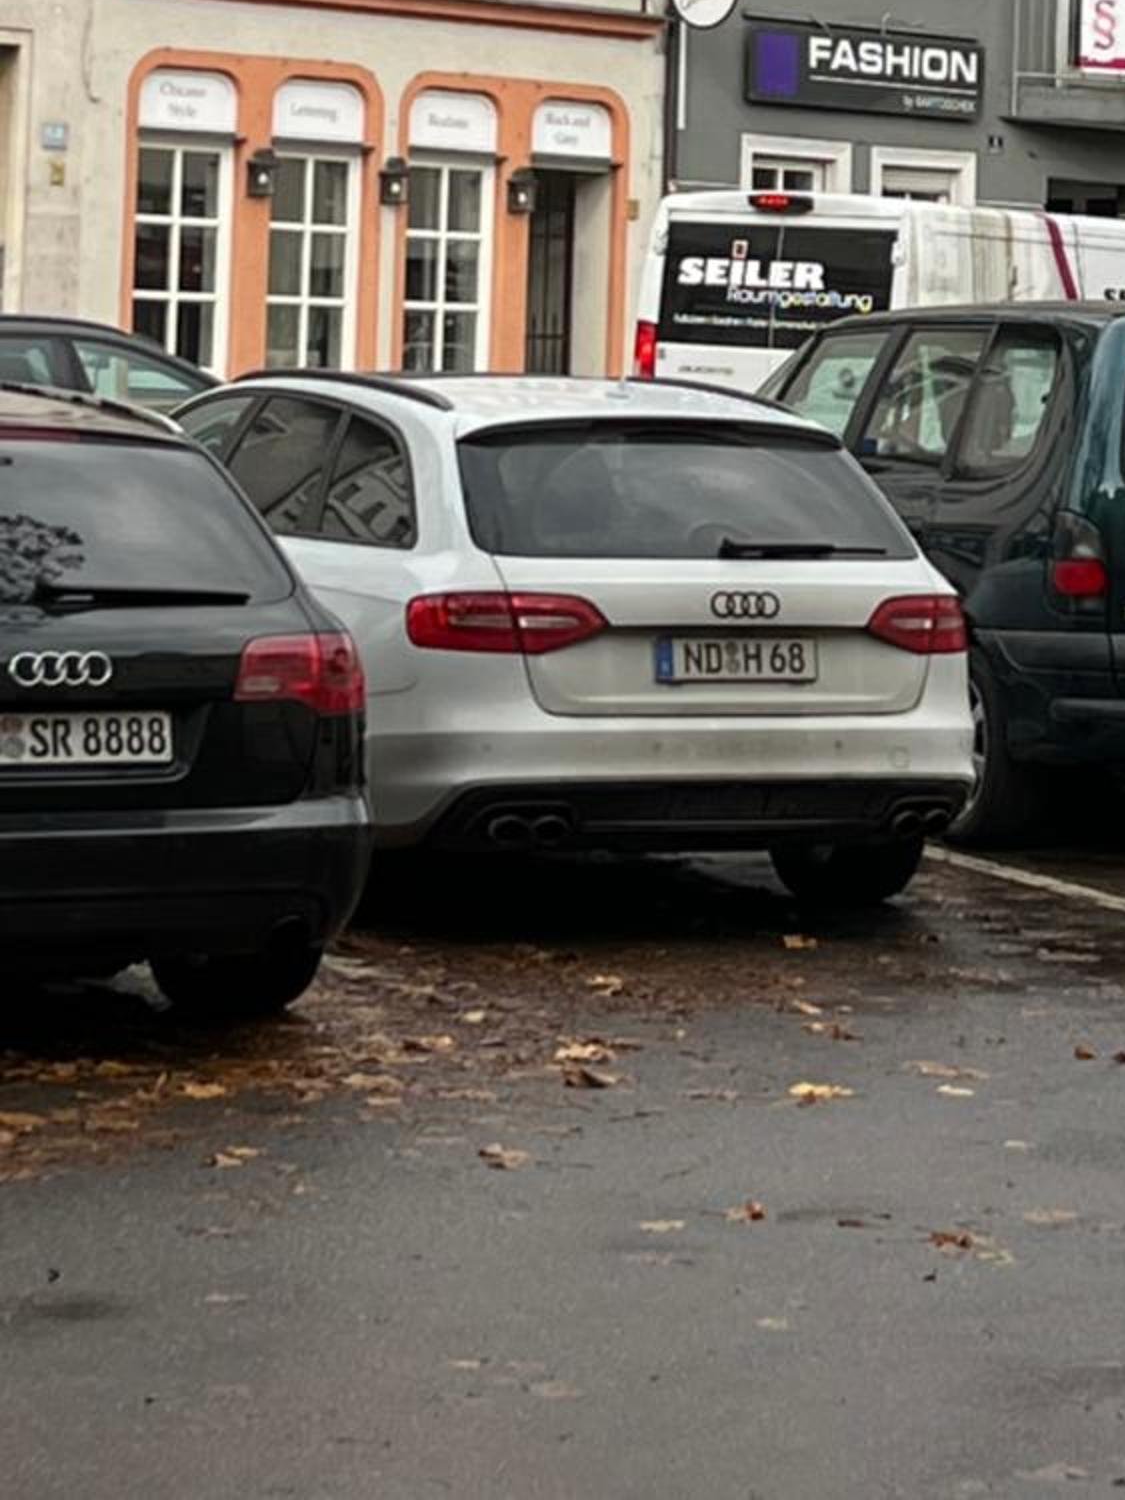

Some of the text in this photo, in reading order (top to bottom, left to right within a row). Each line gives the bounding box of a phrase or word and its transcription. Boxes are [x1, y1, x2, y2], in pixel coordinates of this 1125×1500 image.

[808, 36, 978, 84] FASHION
[727, 285, 873, 312] Raumgestaltung
[683, 641, 806, 675] ND H 68
[29, 716, 167, 758] SR 8888
